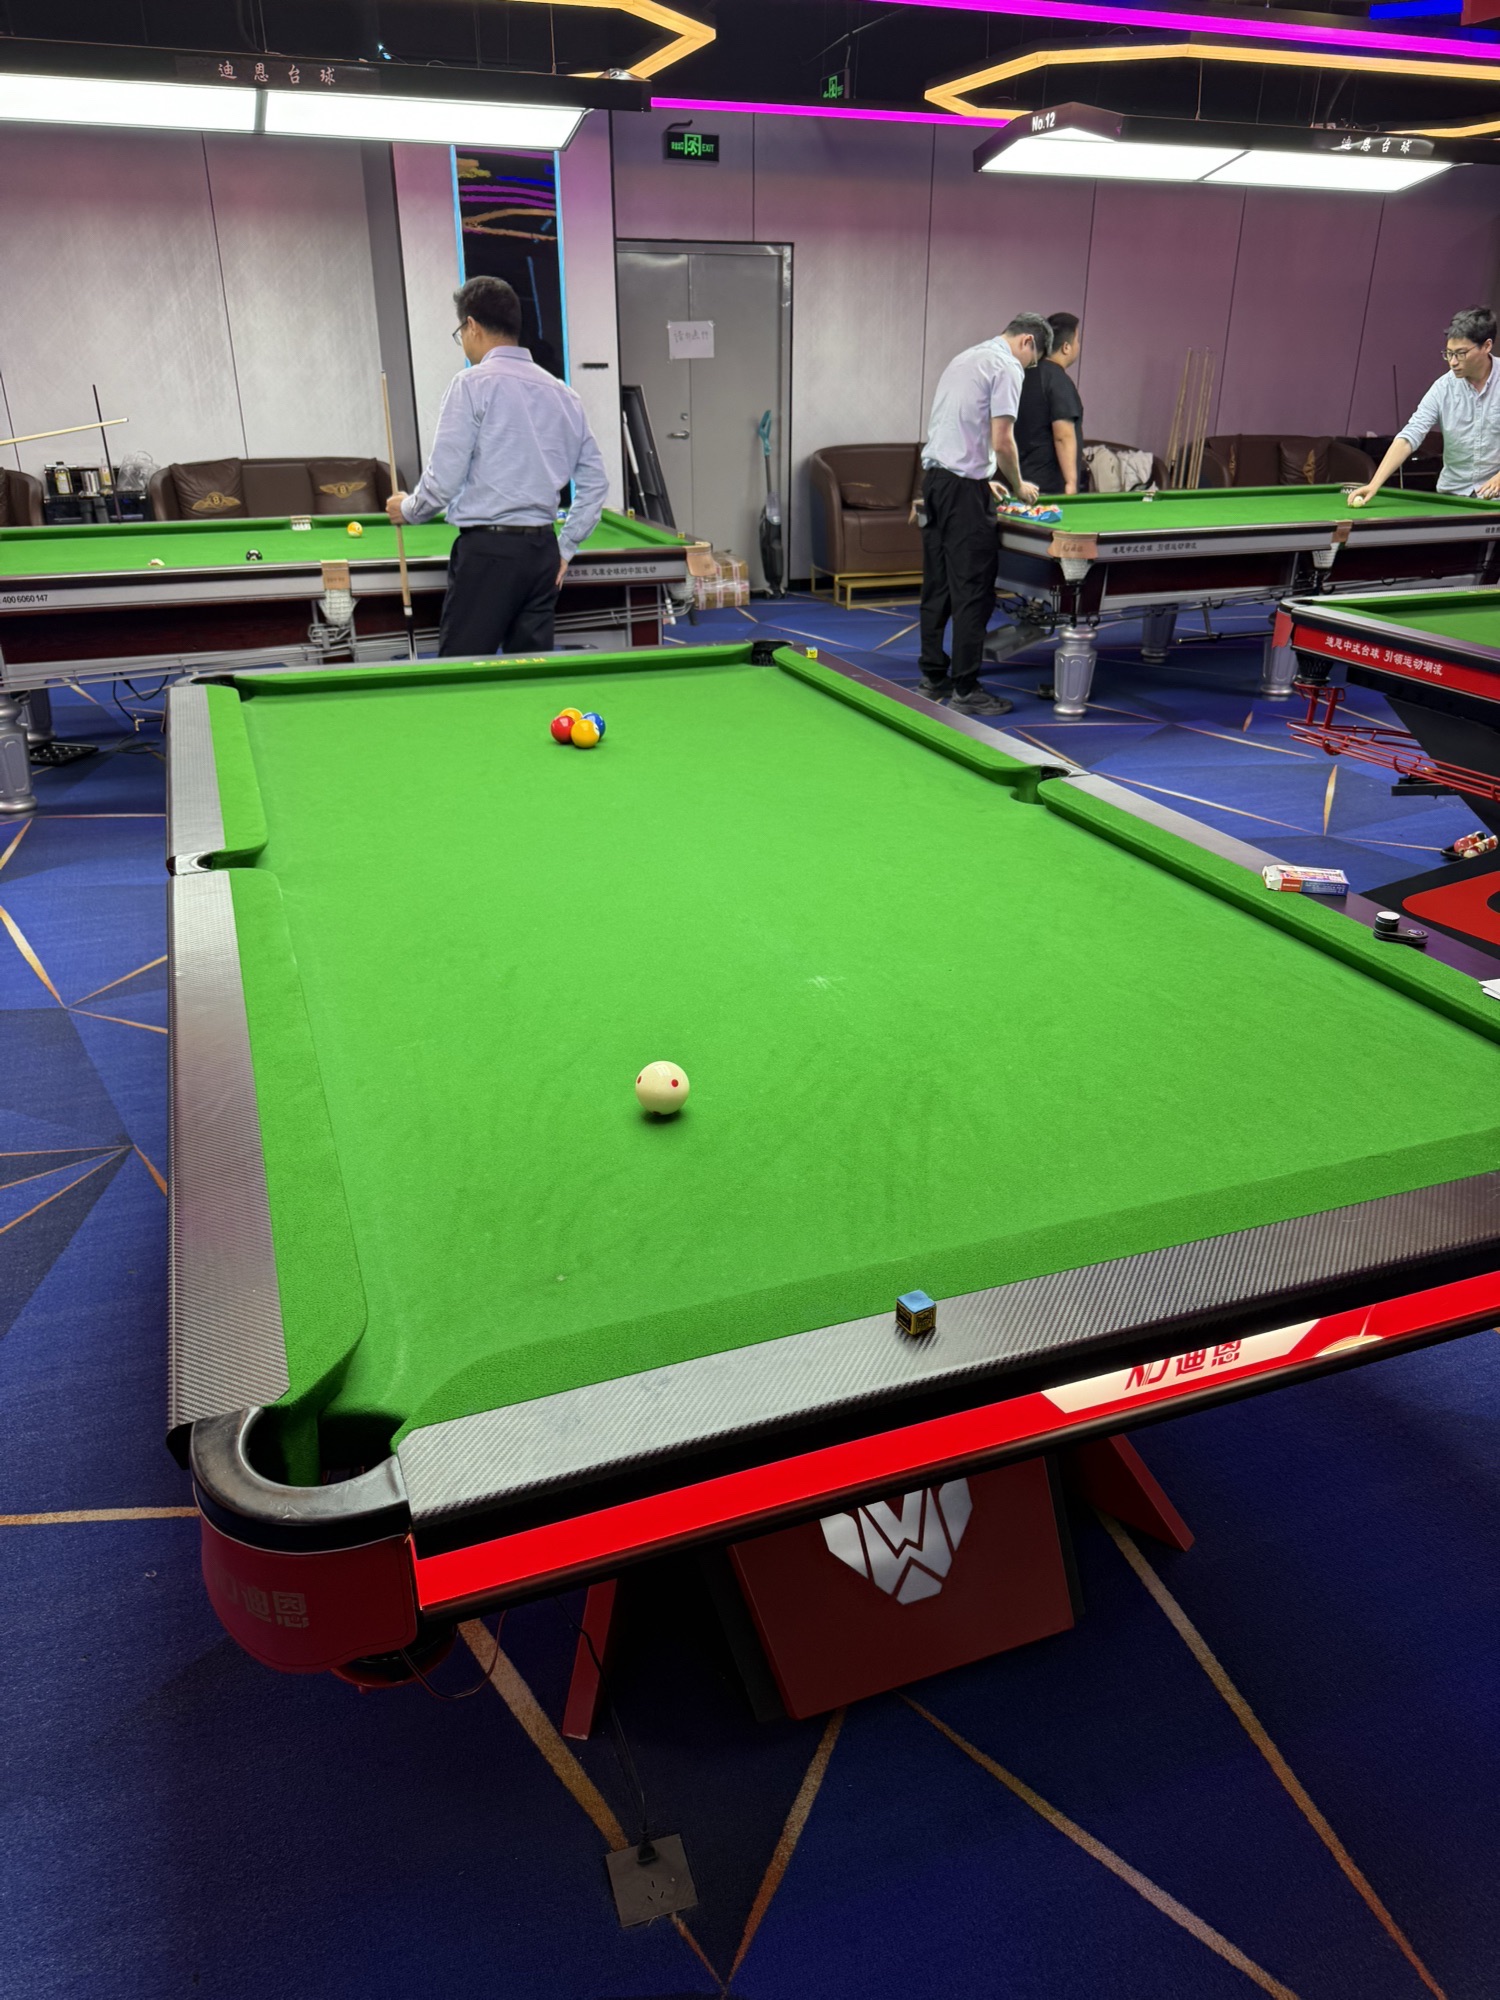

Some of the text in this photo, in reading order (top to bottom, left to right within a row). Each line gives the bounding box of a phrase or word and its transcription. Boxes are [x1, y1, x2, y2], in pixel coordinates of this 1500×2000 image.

[218, 60, 336, 86] 迪恩台球
[1032, 111, 1056, 132] No.12
[702, 143, 715, 153] EXIT
